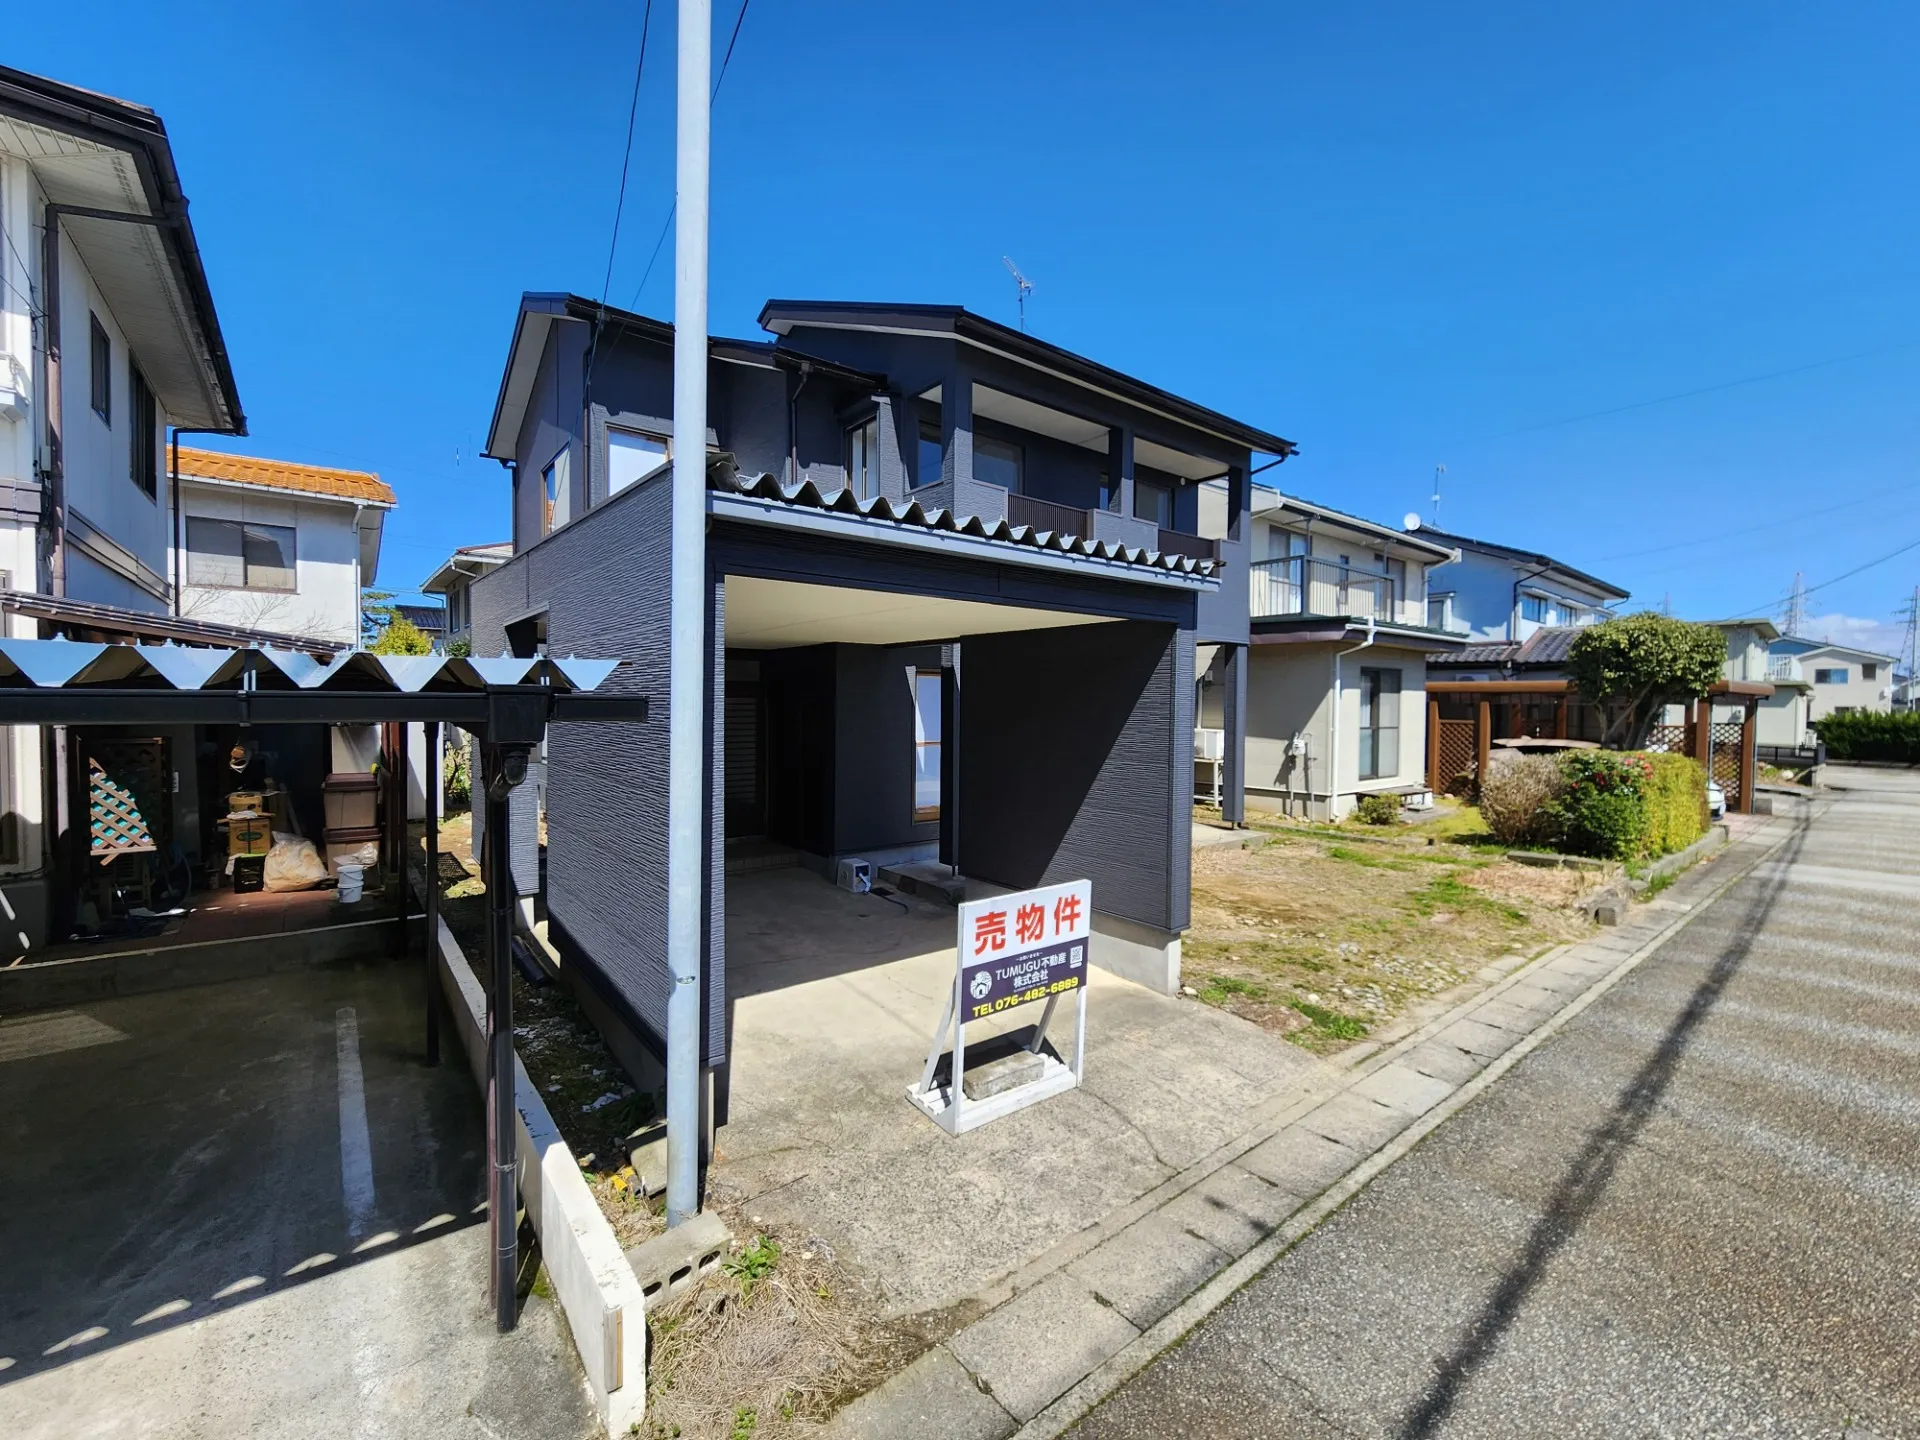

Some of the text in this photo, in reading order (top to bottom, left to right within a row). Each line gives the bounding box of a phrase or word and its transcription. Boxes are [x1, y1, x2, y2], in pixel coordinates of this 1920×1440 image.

[974, 894, 1081, 956] 売物件
[1013, 969, 1049, 989] 株式会社
